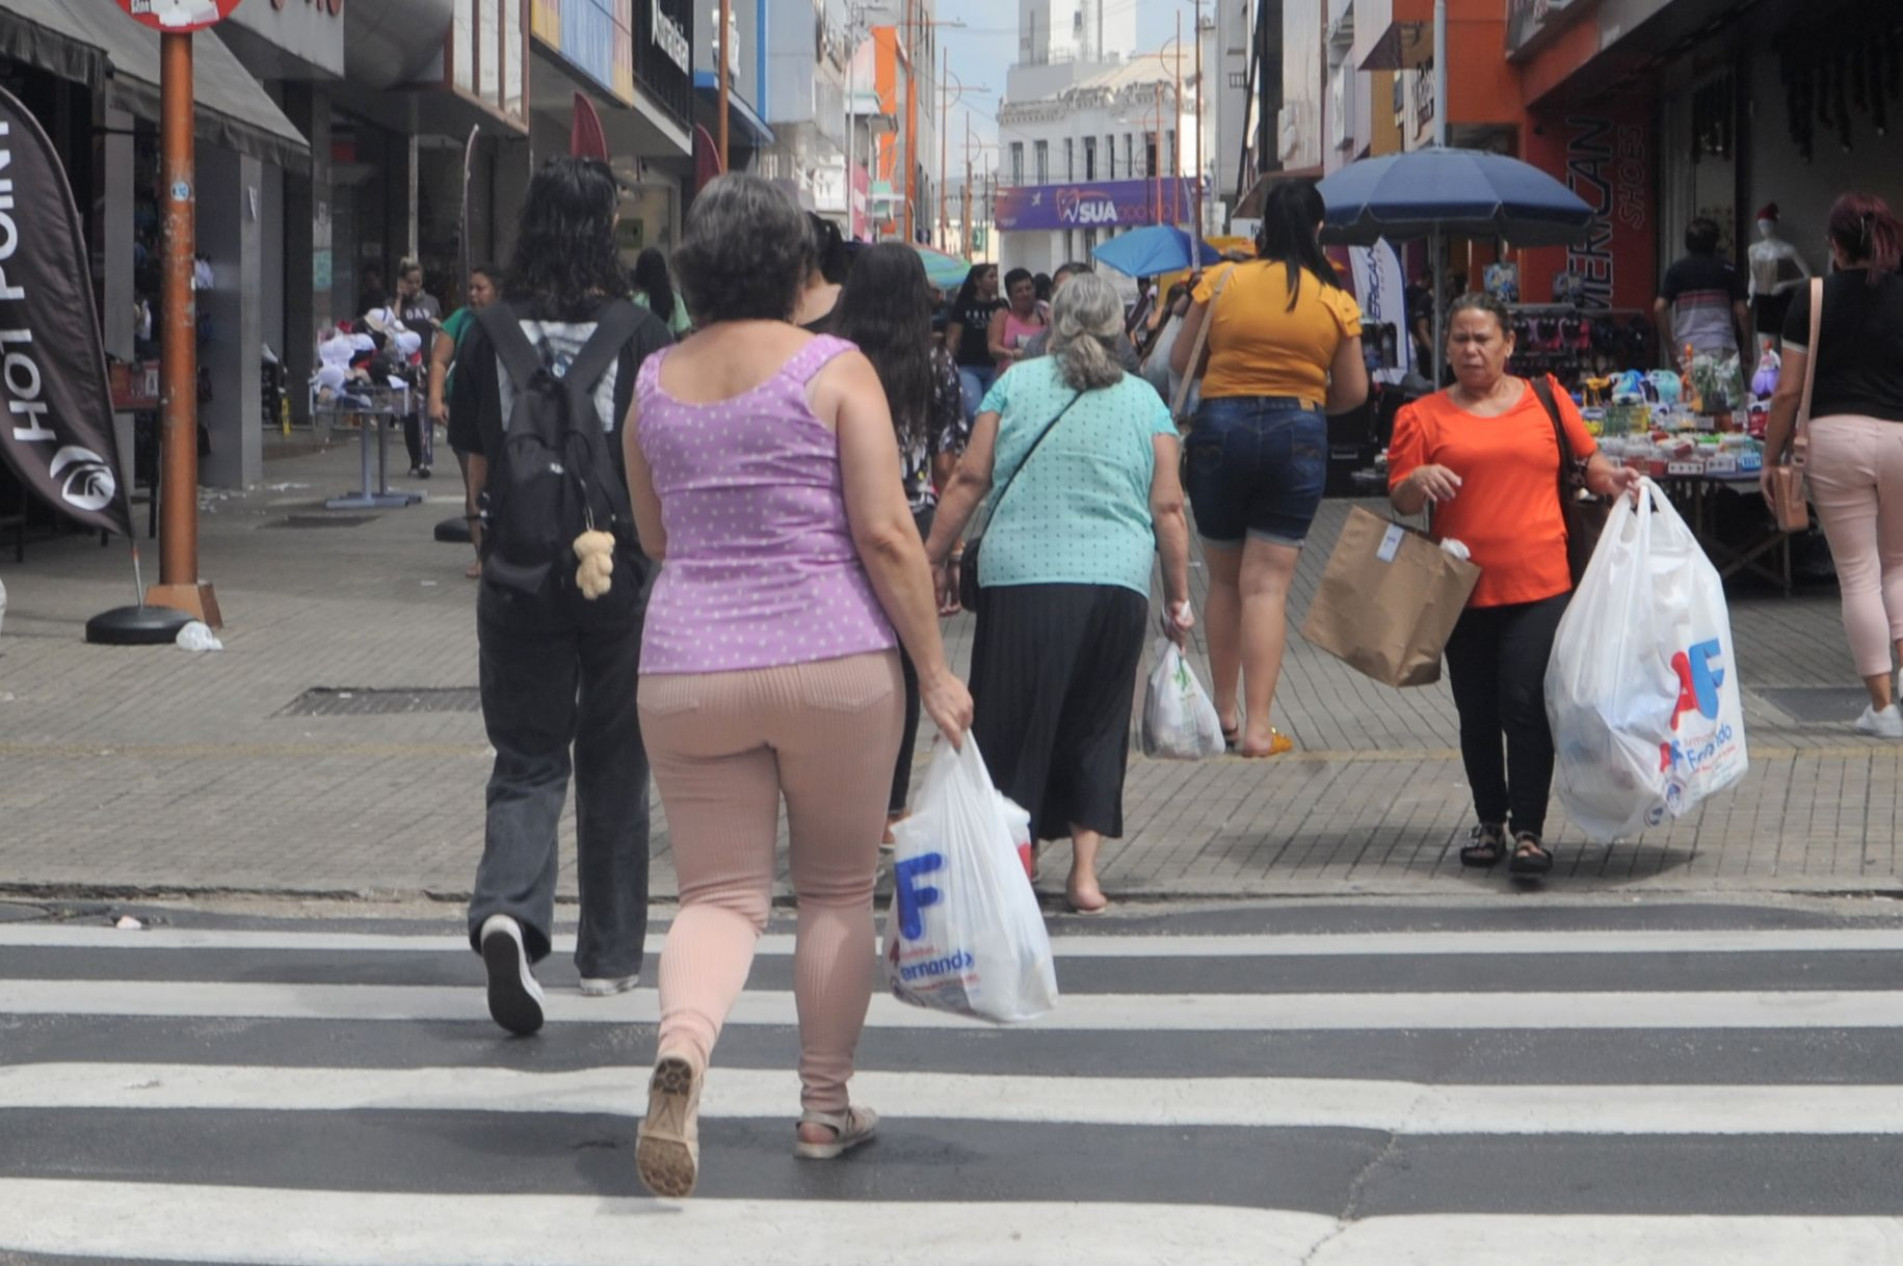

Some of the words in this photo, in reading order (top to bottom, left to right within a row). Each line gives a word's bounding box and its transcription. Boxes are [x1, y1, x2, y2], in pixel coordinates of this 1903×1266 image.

[1079, 200, 1118, 223] SUA
[1618, 125, 1646, 230] SHOES
[0, 328, 56, 441] HOT
